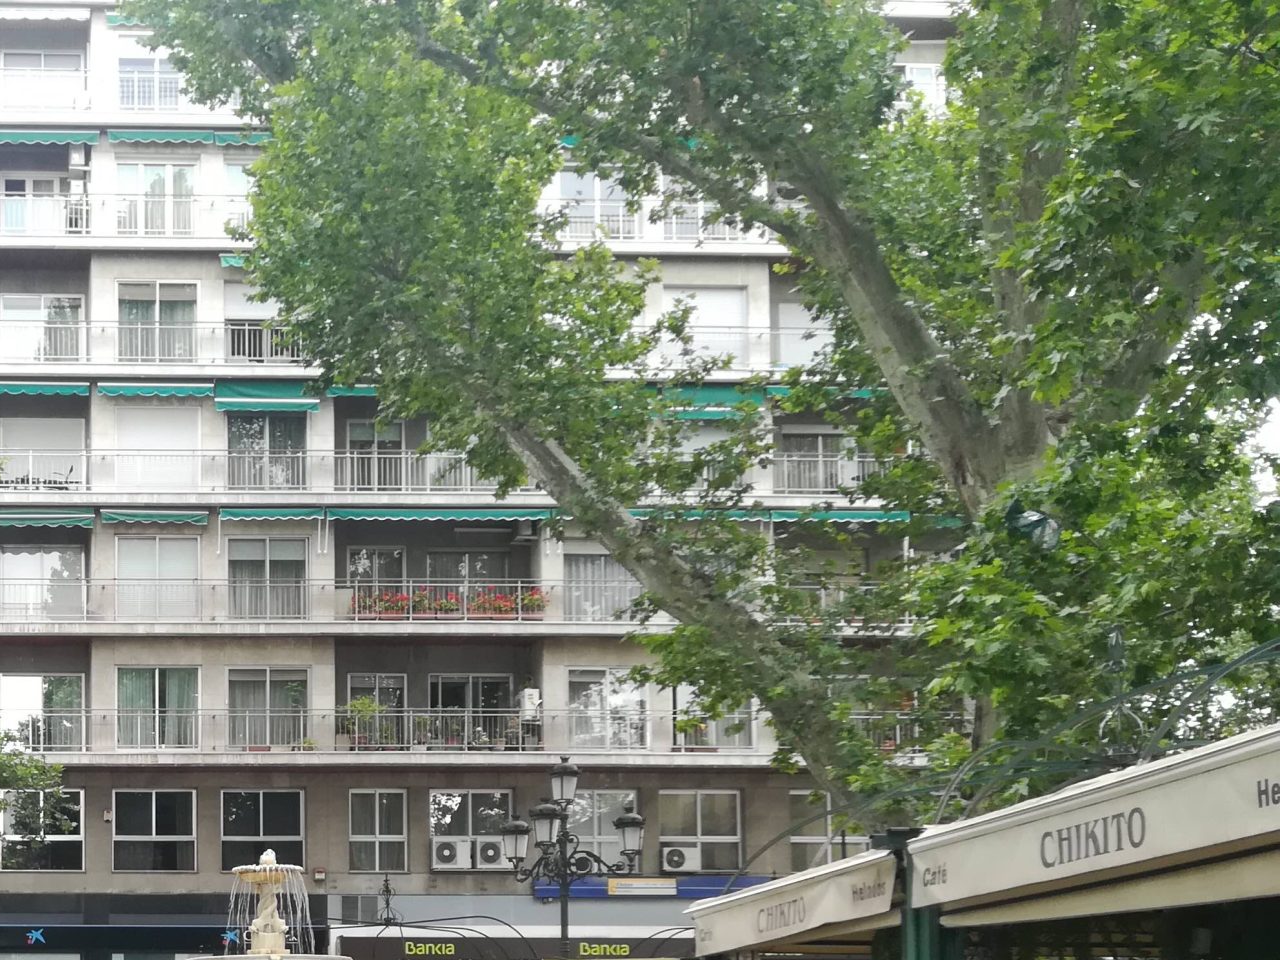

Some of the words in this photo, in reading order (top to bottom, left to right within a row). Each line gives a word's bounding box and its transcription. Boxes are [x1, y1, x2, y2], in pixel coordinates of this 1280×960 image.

[1040, 806, 1146, 869] CHIKITO
[923, 863, 947, 887] Café
[757, 896, 806, 933] CHIKITO
[405, 941, 455, 955] Bankia
[579, 942, 630, 956] Bankia
